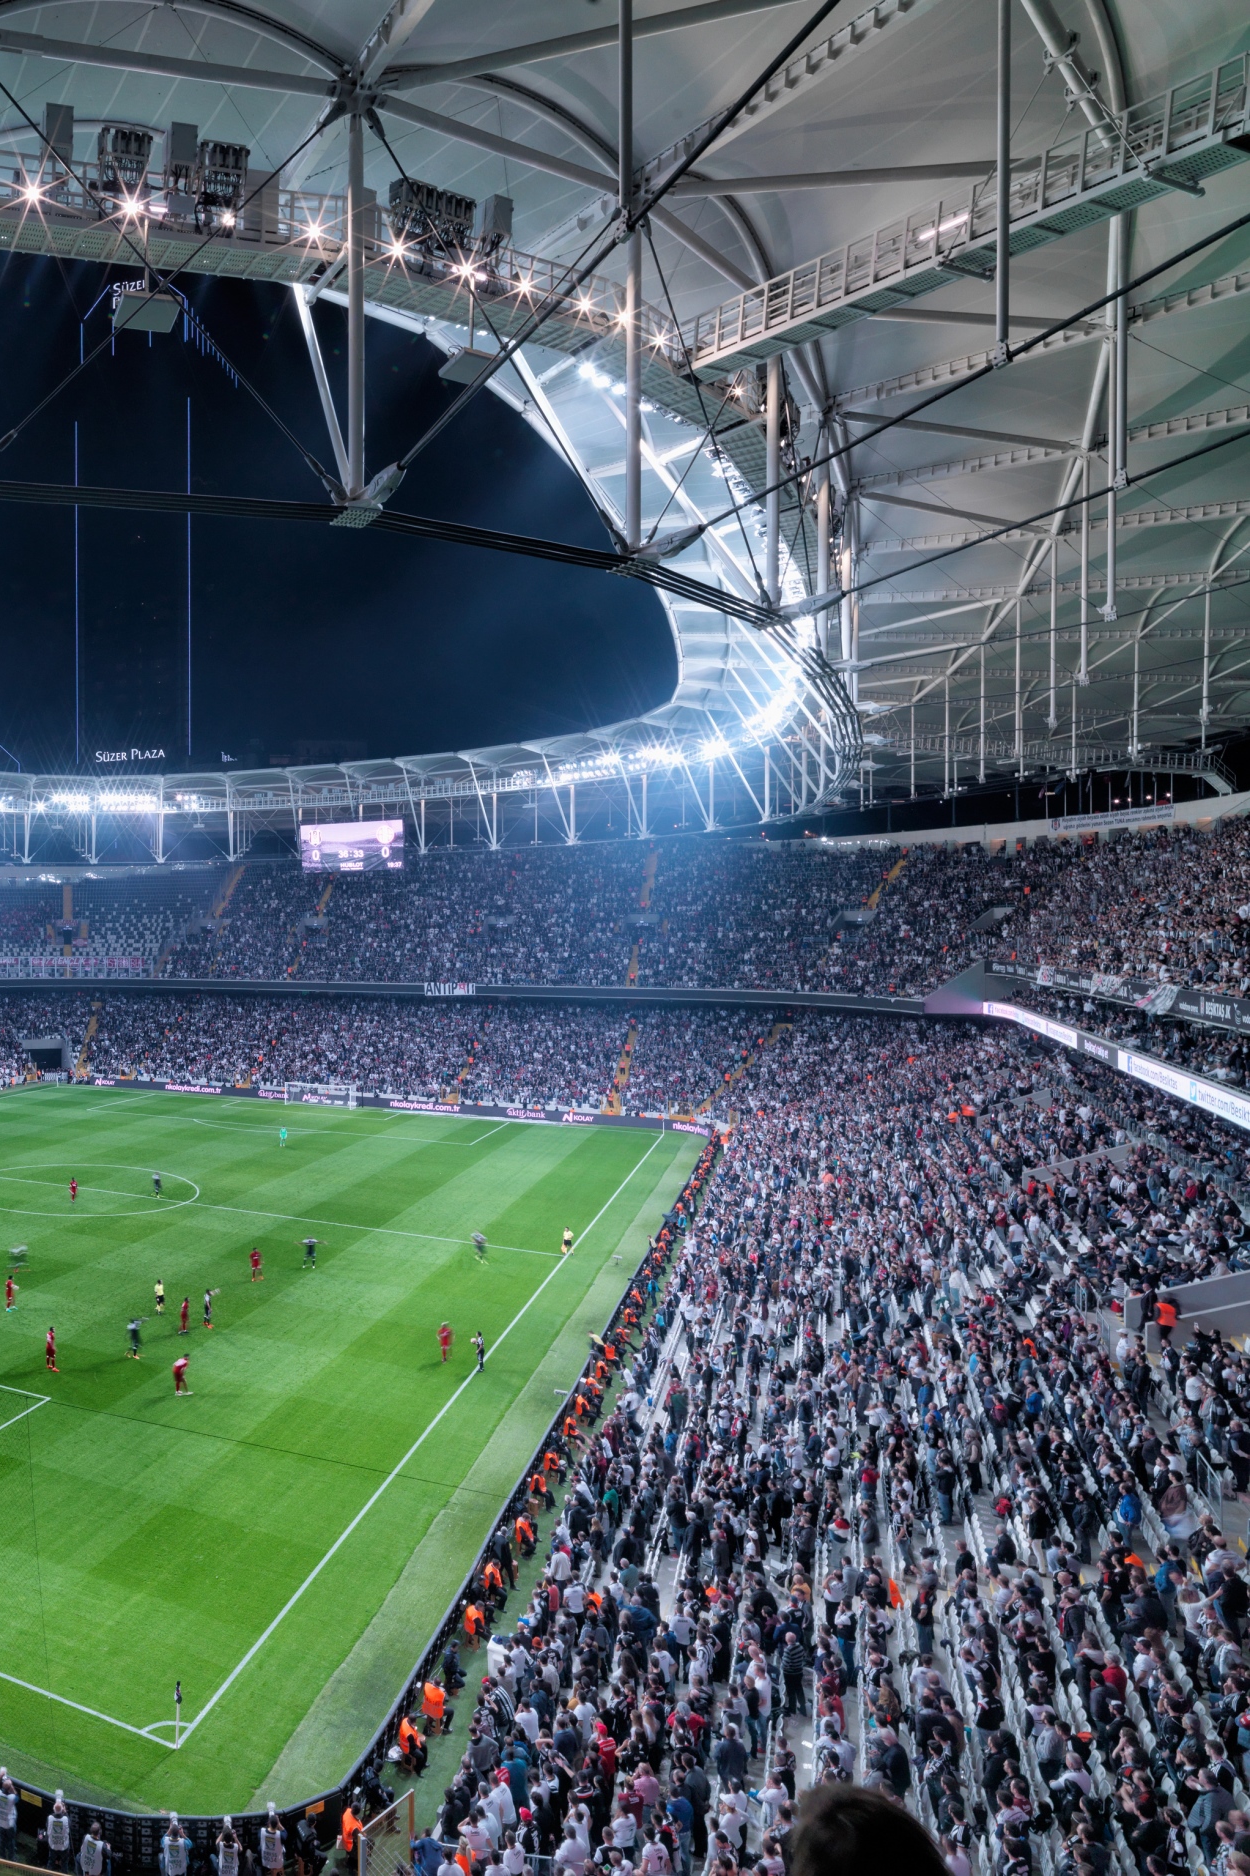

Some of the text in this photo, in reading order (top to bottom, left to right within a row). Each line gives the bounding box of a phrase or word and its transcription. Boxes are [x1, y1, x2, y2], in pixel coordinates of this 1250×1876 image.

[96, 748, 166, 762] SÜZER PLAZA
[312, 850, 320, 860] 0
[381, 846, 390, 858] 0
[1206, 998, 1231, 1021] BEŞİKTAŞ JK
[1133, 1060, 1178, 1090] facebook.com/Besiktas
[165, 1084, 222, 1094] nkolaykredi.com.tr
[390, 1100, 460, 1112] nkolaykredi.com.tr
